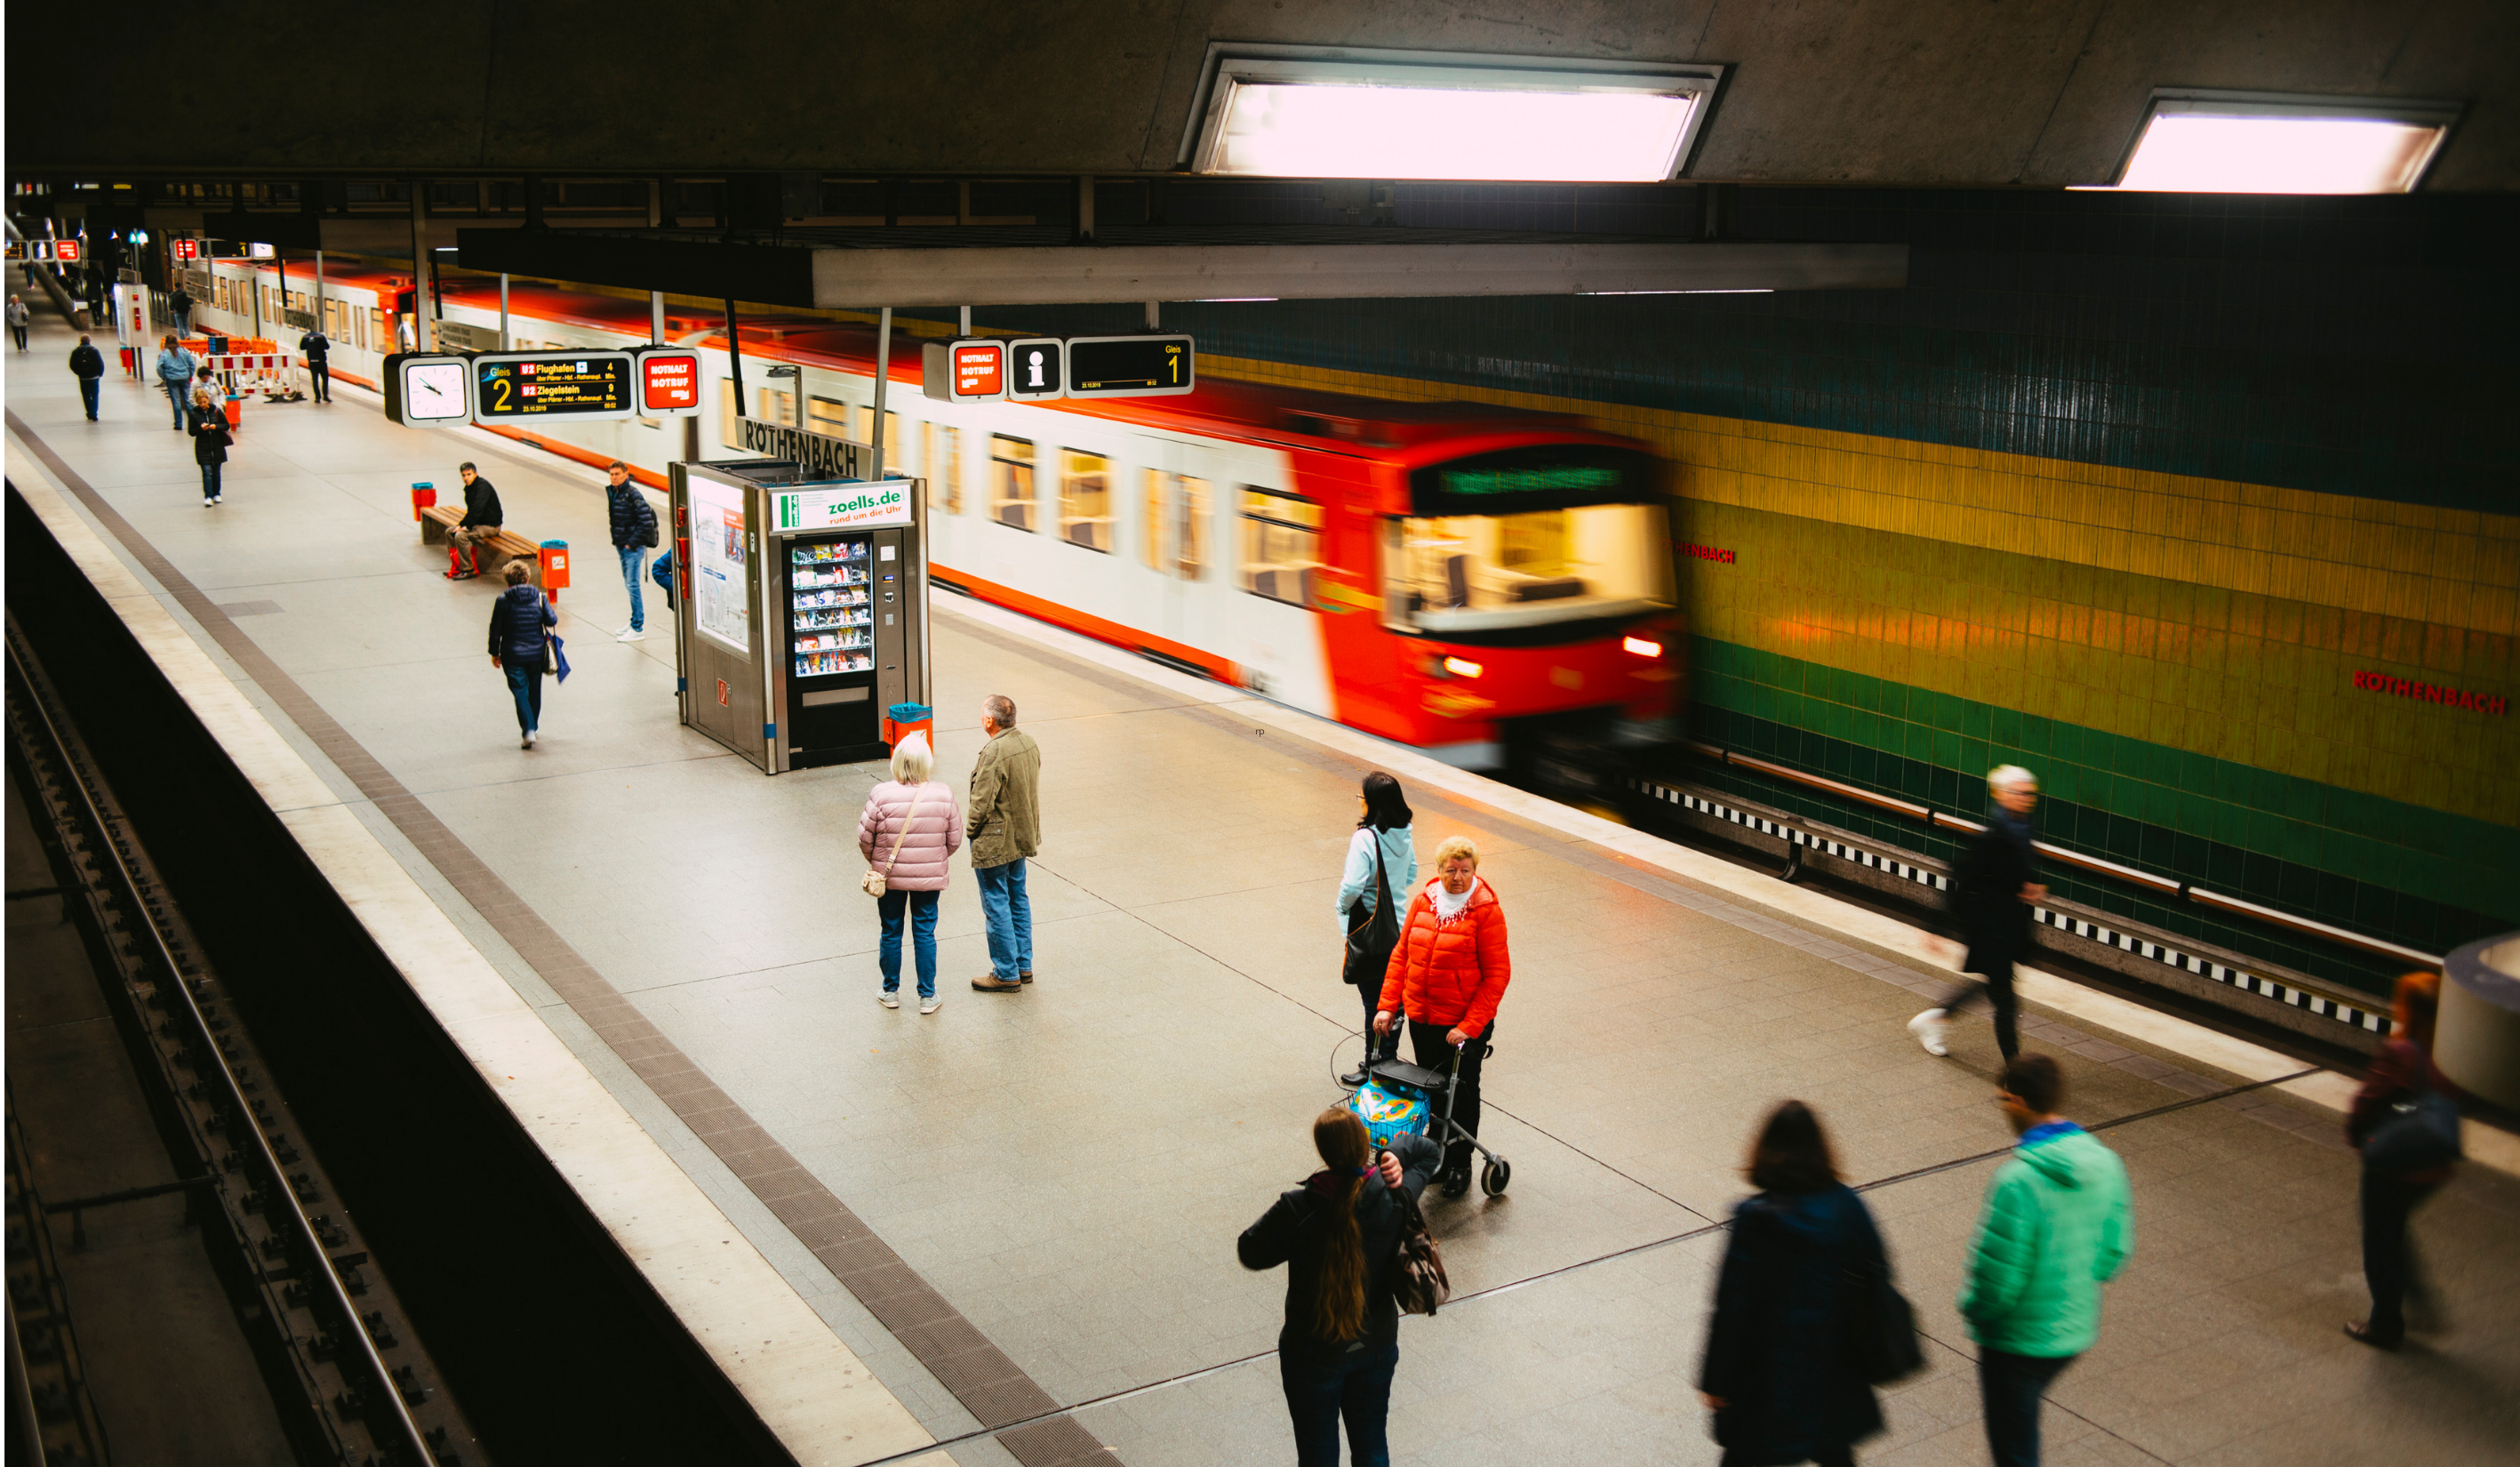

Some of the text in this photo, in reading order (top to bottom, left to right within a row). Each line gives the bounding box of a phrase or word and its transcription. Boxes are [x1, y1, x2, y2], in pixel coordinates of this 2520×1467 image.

[1165, 345, 1181, 354] Gleis
[961, 354, 994, 363] NOTHALT
[490, 367, 511, 377] Gleis
[522, 362, 613, 374] U2 Flughafen 4
[651, 365, 688, 374] NOTHALT
[961, 366, 995, 375] NOTRUF
[1169, 355, 1178, 383] 1
[652, 377, 689, 388] NOTRUF
[493, 379, 512, 412] 2
[523, 383, 614, 397] U2 Ziegelstein 9
[523, 405, 547, 413] 23.10.2019
[746, 420, 857, 477] RÖTHENBACH
[828, 491, 900, 515] zoells.de
[829, 514, 851, 525] rund
[869, 508, 884, 517] die
[885, 505, 902, 515] Uhr
[2353, 670, 2507, 716] RÖTHENBACH
